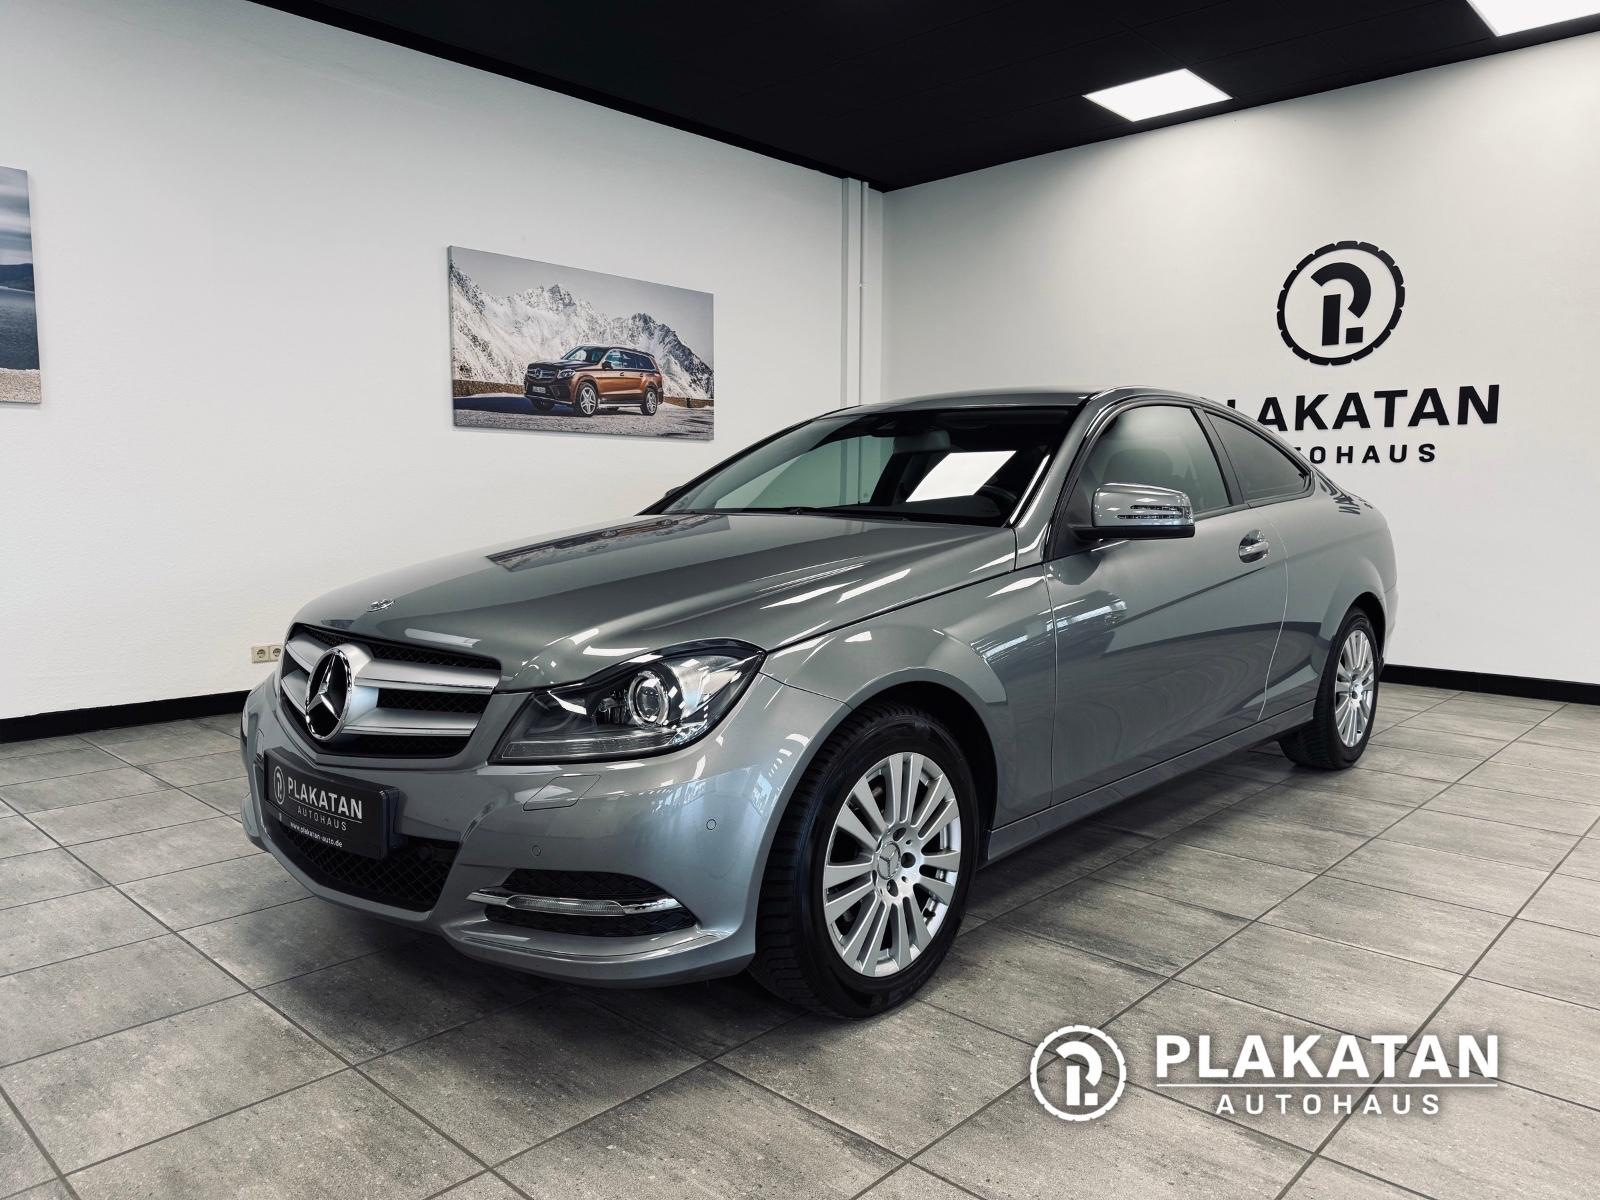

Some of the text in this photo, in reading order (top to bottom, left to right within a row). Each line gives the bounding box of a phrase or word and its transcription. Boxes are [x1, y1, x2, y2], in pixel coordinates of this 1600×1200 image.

[1227, 384, 1499, 432] AKATAN
[1294, 443, 1436, 464] OHAUS
[288, 776, 363, 820] PLAKATAN
[297, 805, 348, 831] AUTOHAUS
[290, 822, 343, 848] www.plakatan-auto.de
